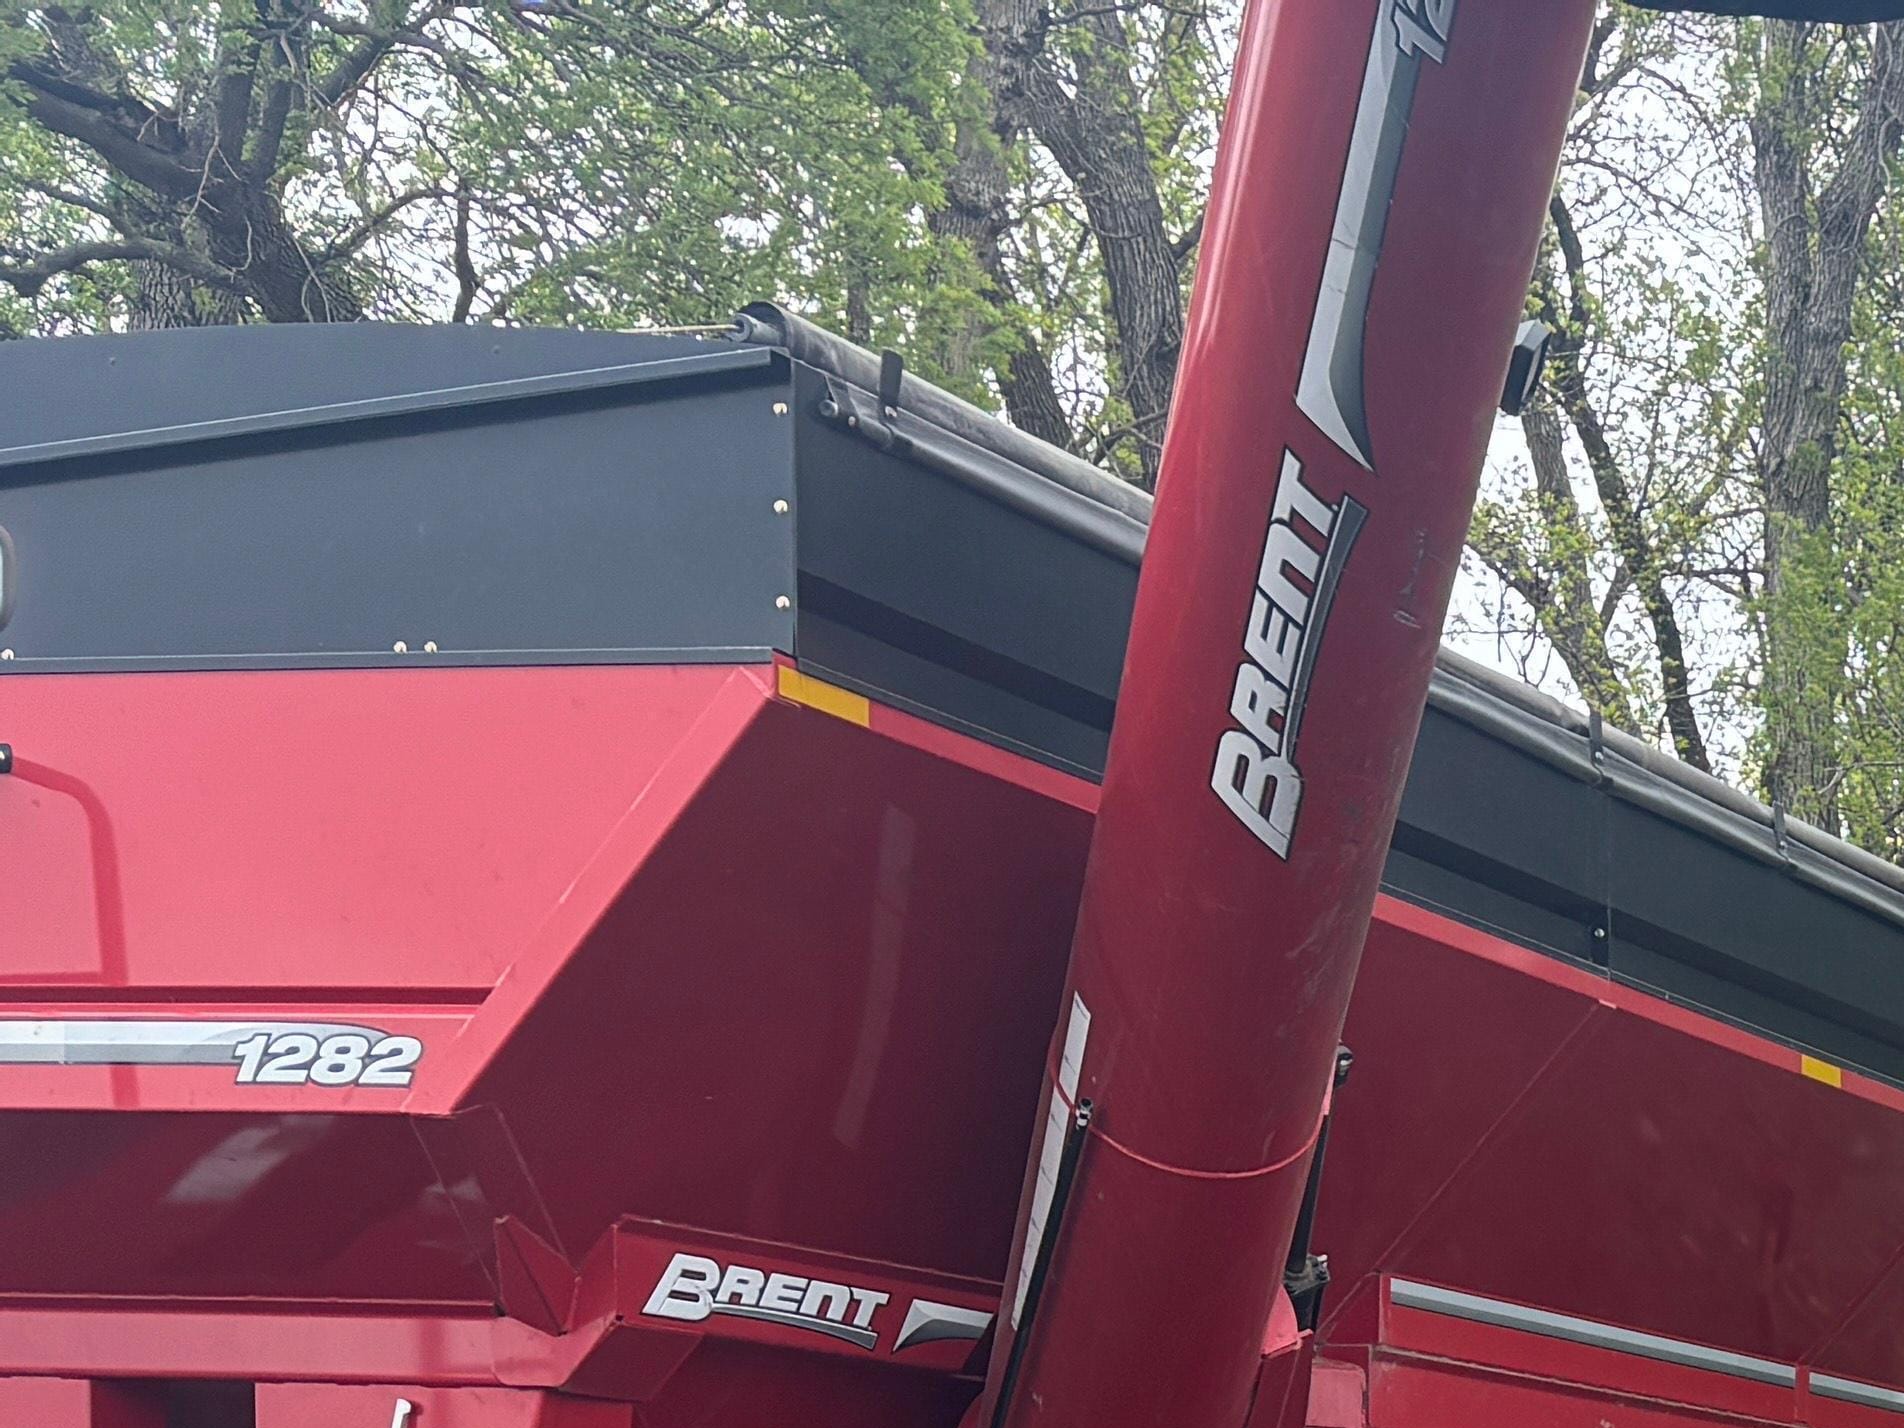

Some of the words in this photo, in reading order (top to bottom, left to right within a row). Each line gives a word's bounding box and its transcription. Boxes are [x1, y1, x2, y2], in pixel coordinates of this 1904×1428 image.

[1210, 445, 1339, 862] BRENT
[234, 1033, 423, 1087] 1282
[640, 1252, 891, 1330] BRENT
